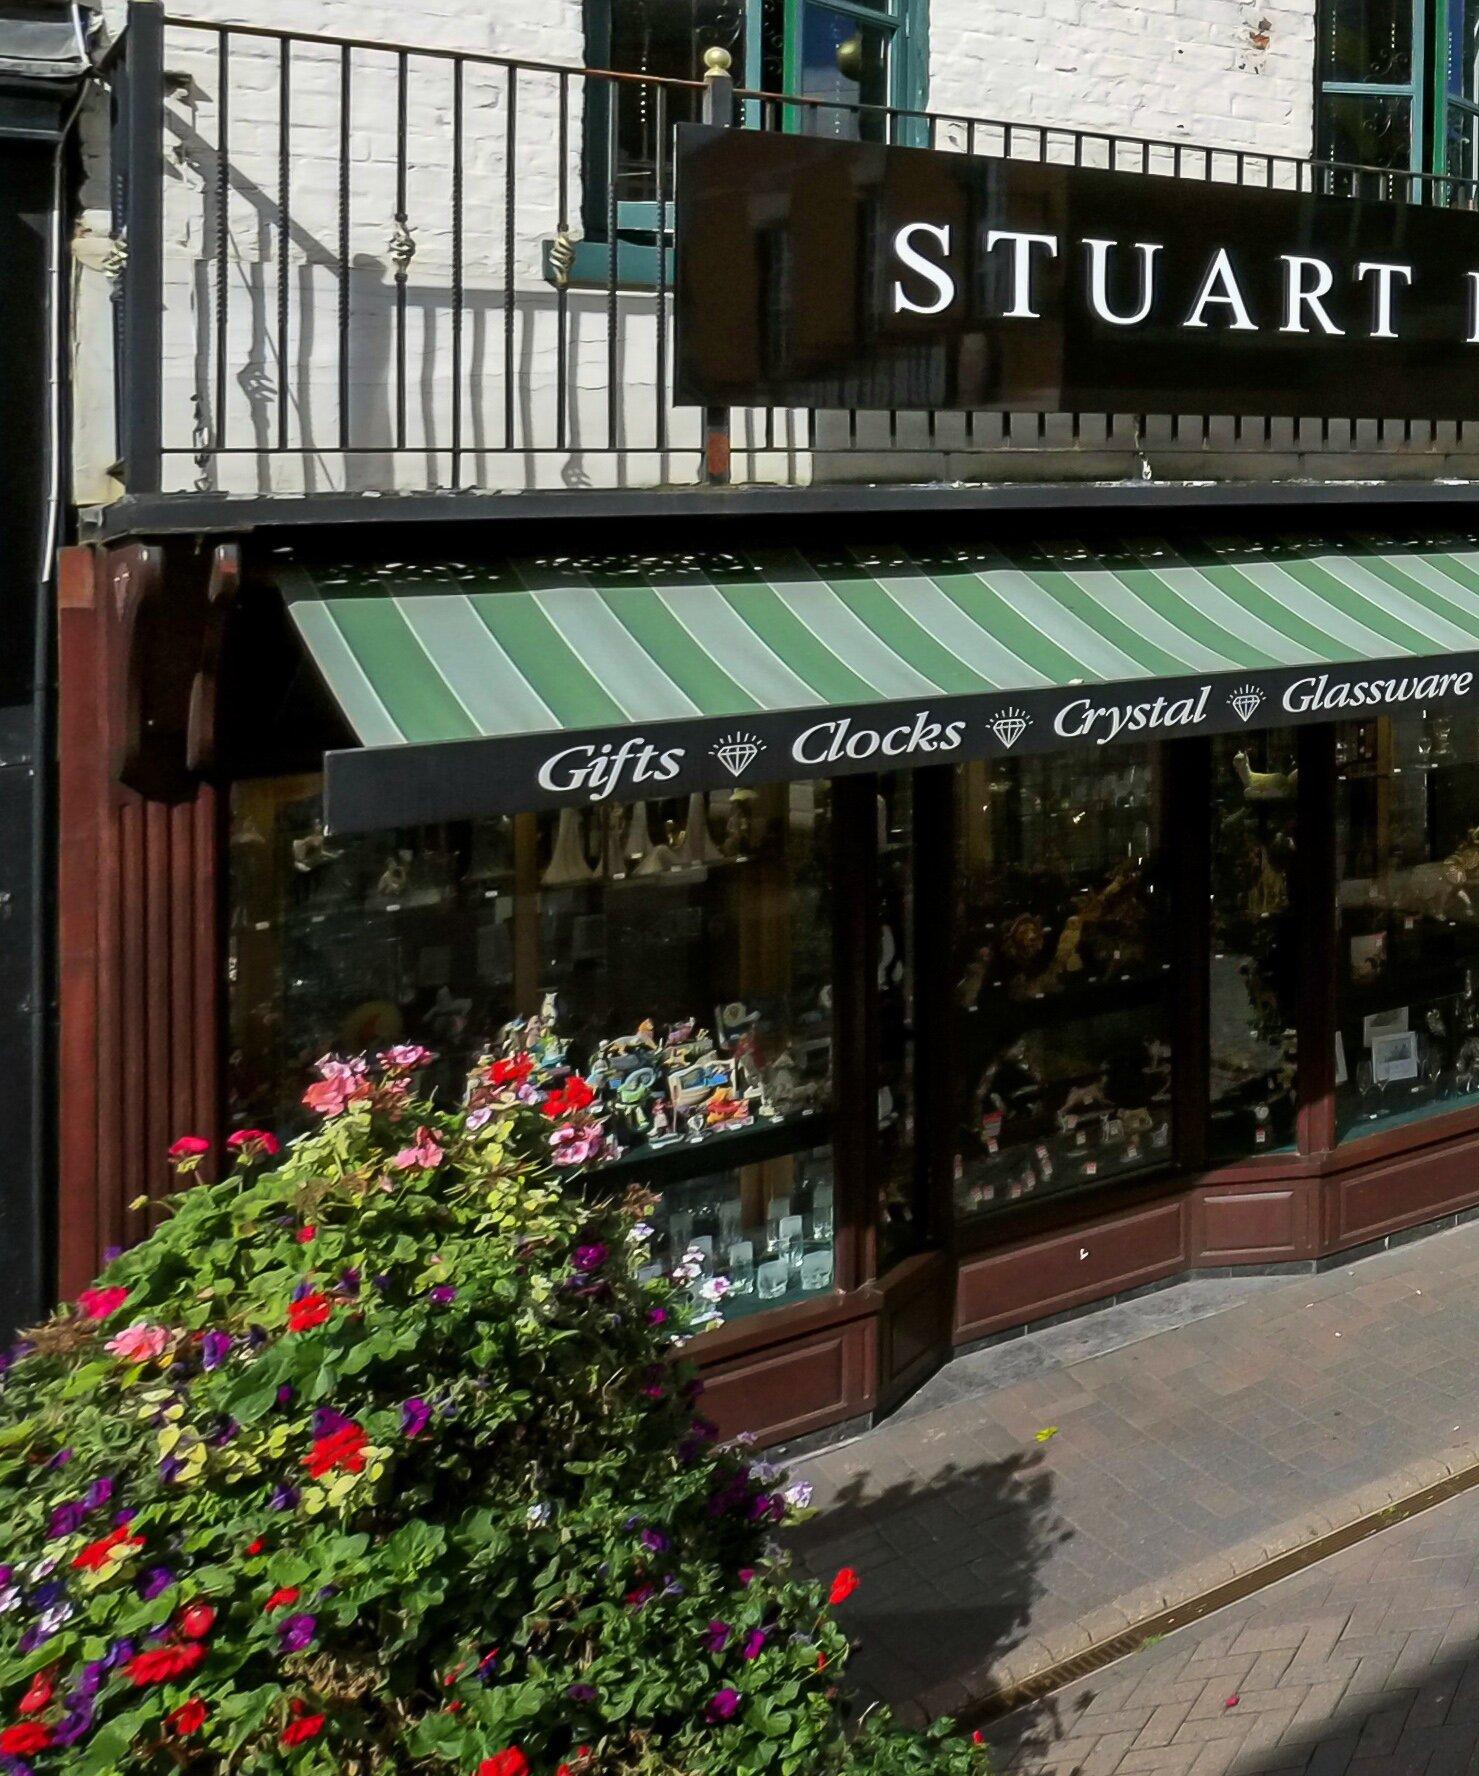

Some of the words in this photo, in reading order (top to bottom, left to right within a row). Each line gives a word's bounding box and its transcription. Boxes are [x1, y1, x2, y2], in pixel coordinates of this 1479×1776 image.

[893, 222, 1412, 339] STUART
[537, 737, 686, 801] Gifts
[791, 710, 967, 764] Clocks
[1053, 685, 1211, 746] Crystal
[1282, 666, 1473, 716] Glassware
